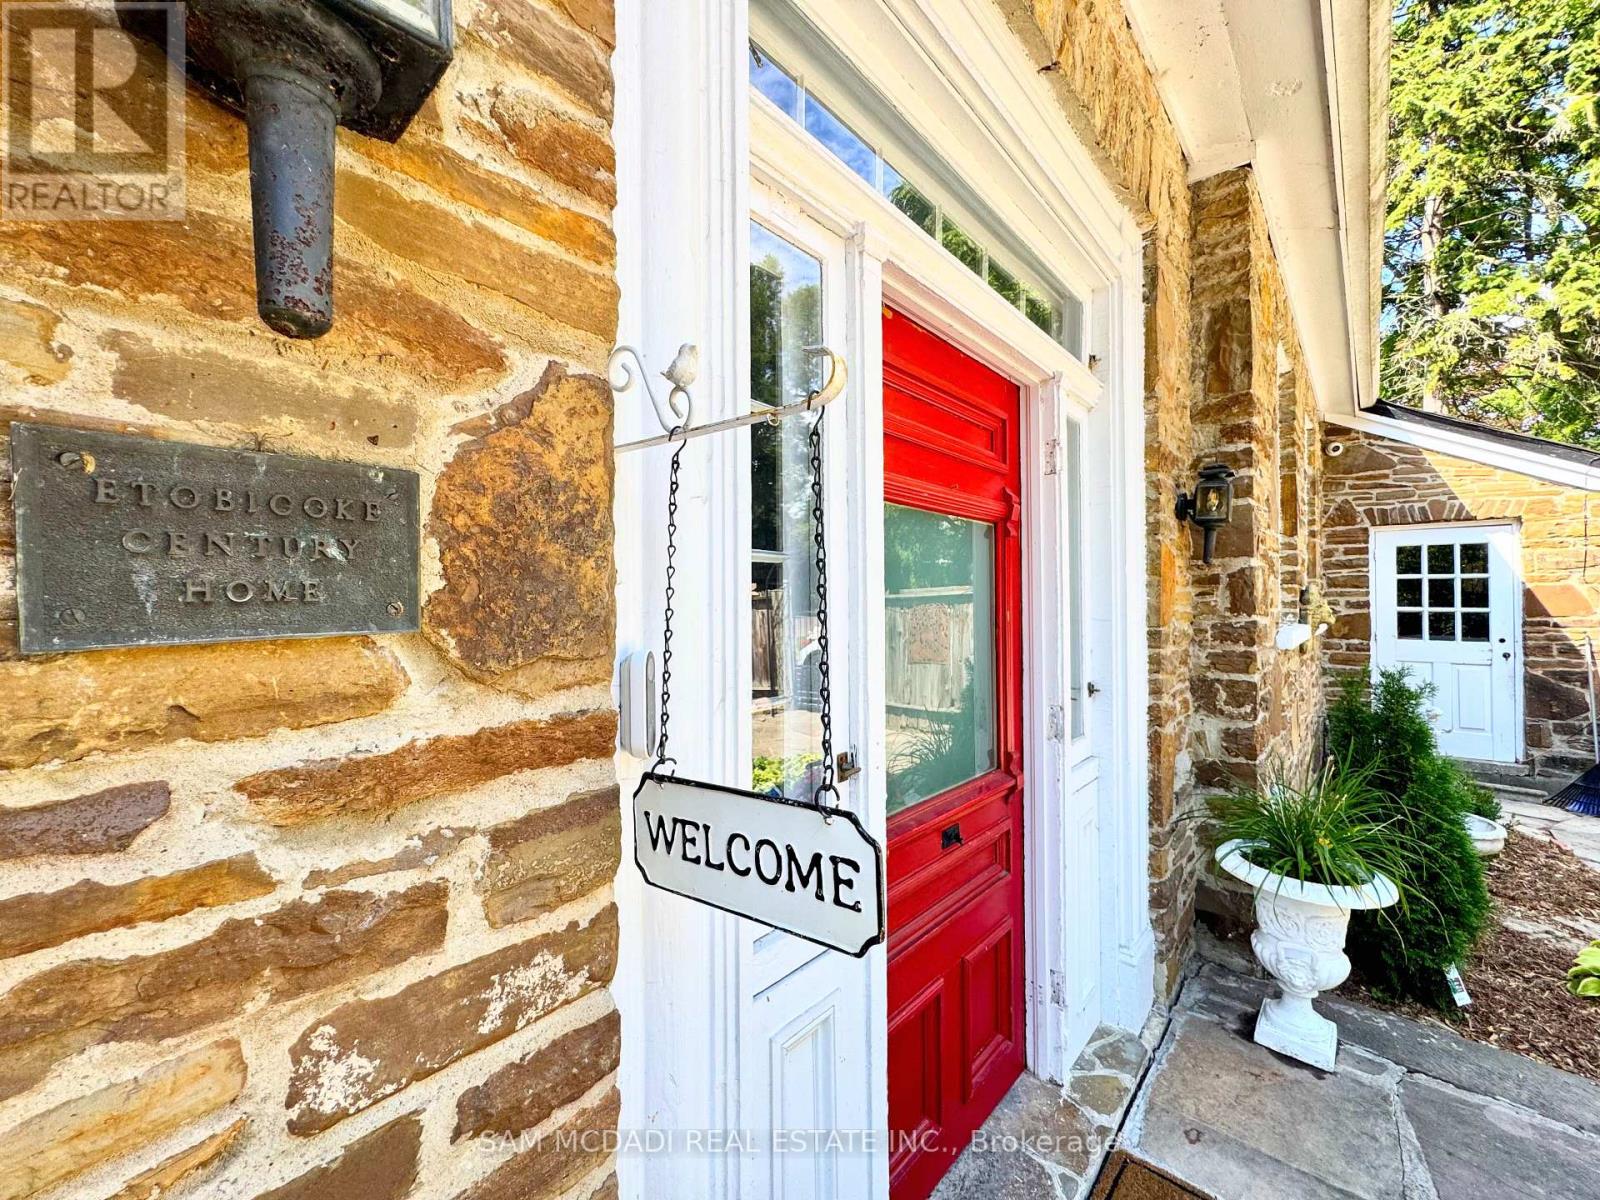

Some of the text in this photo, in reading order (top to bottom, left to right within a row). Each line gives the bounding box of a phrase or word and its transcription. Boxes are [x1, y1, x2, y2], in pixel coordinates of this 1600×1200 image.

[94, 478, 384, 523] ETOBICOKE
[121, 528, 362, 561] CENTURY
[183, 579, 324, 604] HOME
[643, 810, 863, 913] WELCOME
